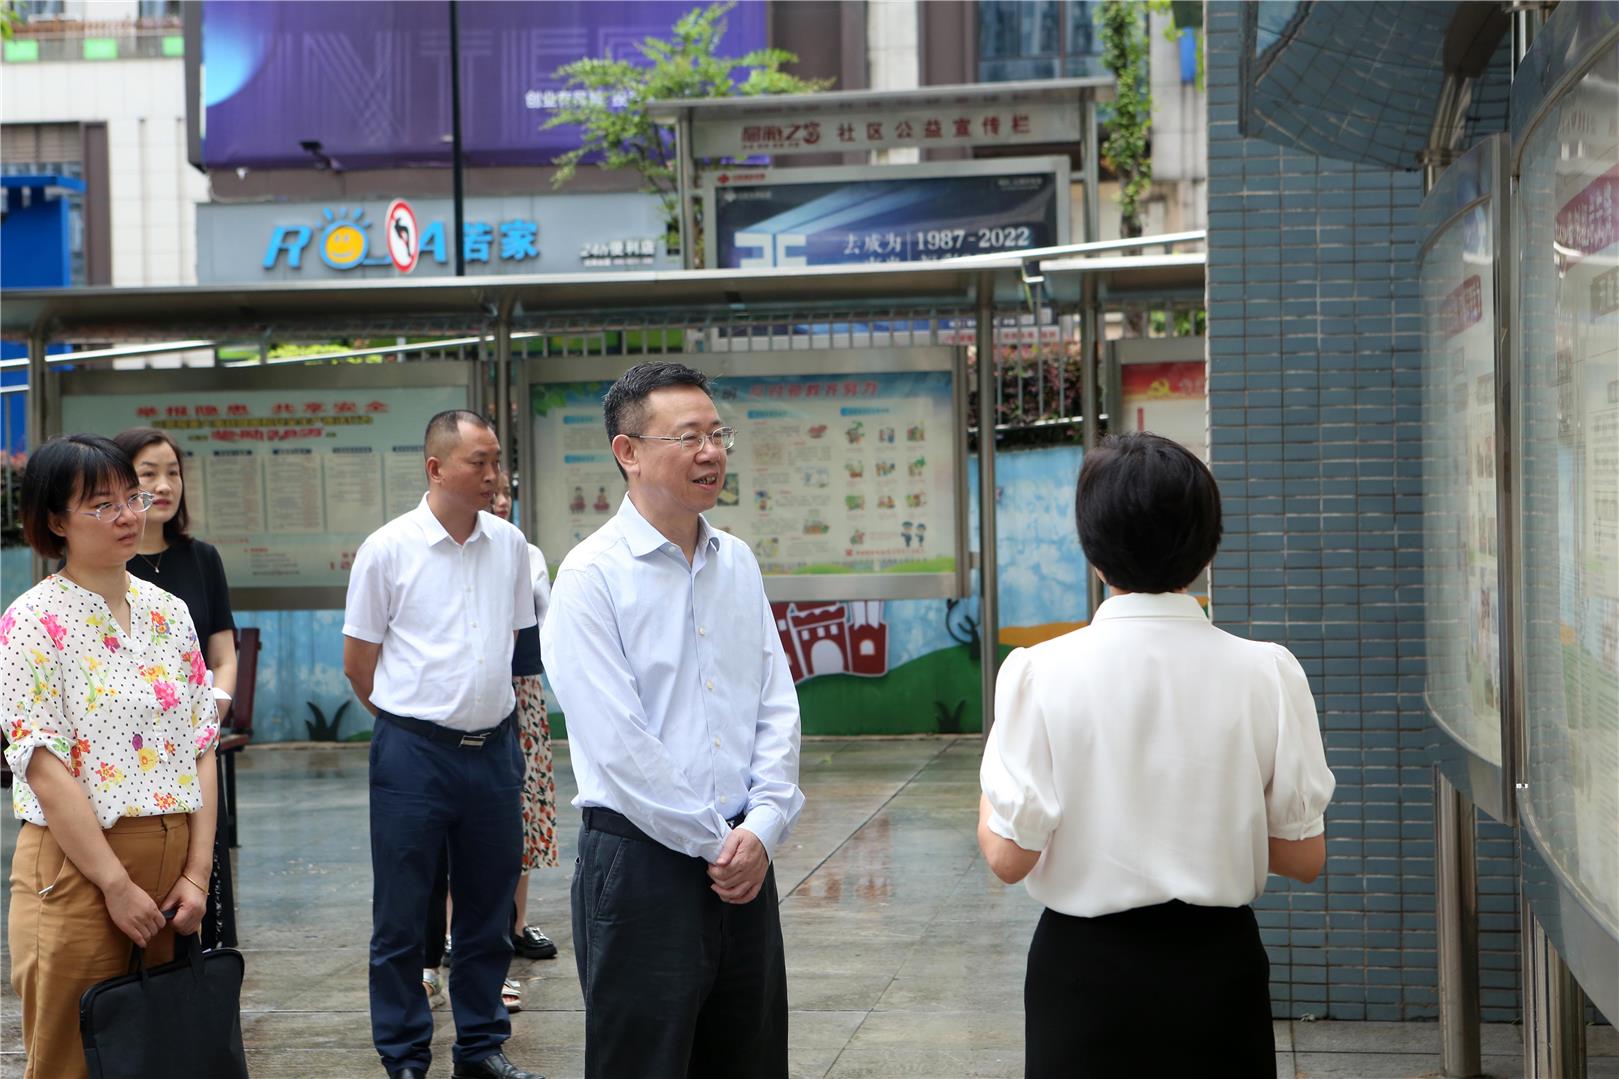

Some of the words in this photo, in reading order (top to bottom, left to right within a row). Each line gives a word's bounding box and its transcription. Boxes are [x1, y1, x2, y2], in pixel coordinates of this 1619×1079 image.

[837, 114, 1031, 142] 社区公益宣传栏
[843, 231, 902, 254] 去成为
[916, 226, 1030, 251] 1987-2022
